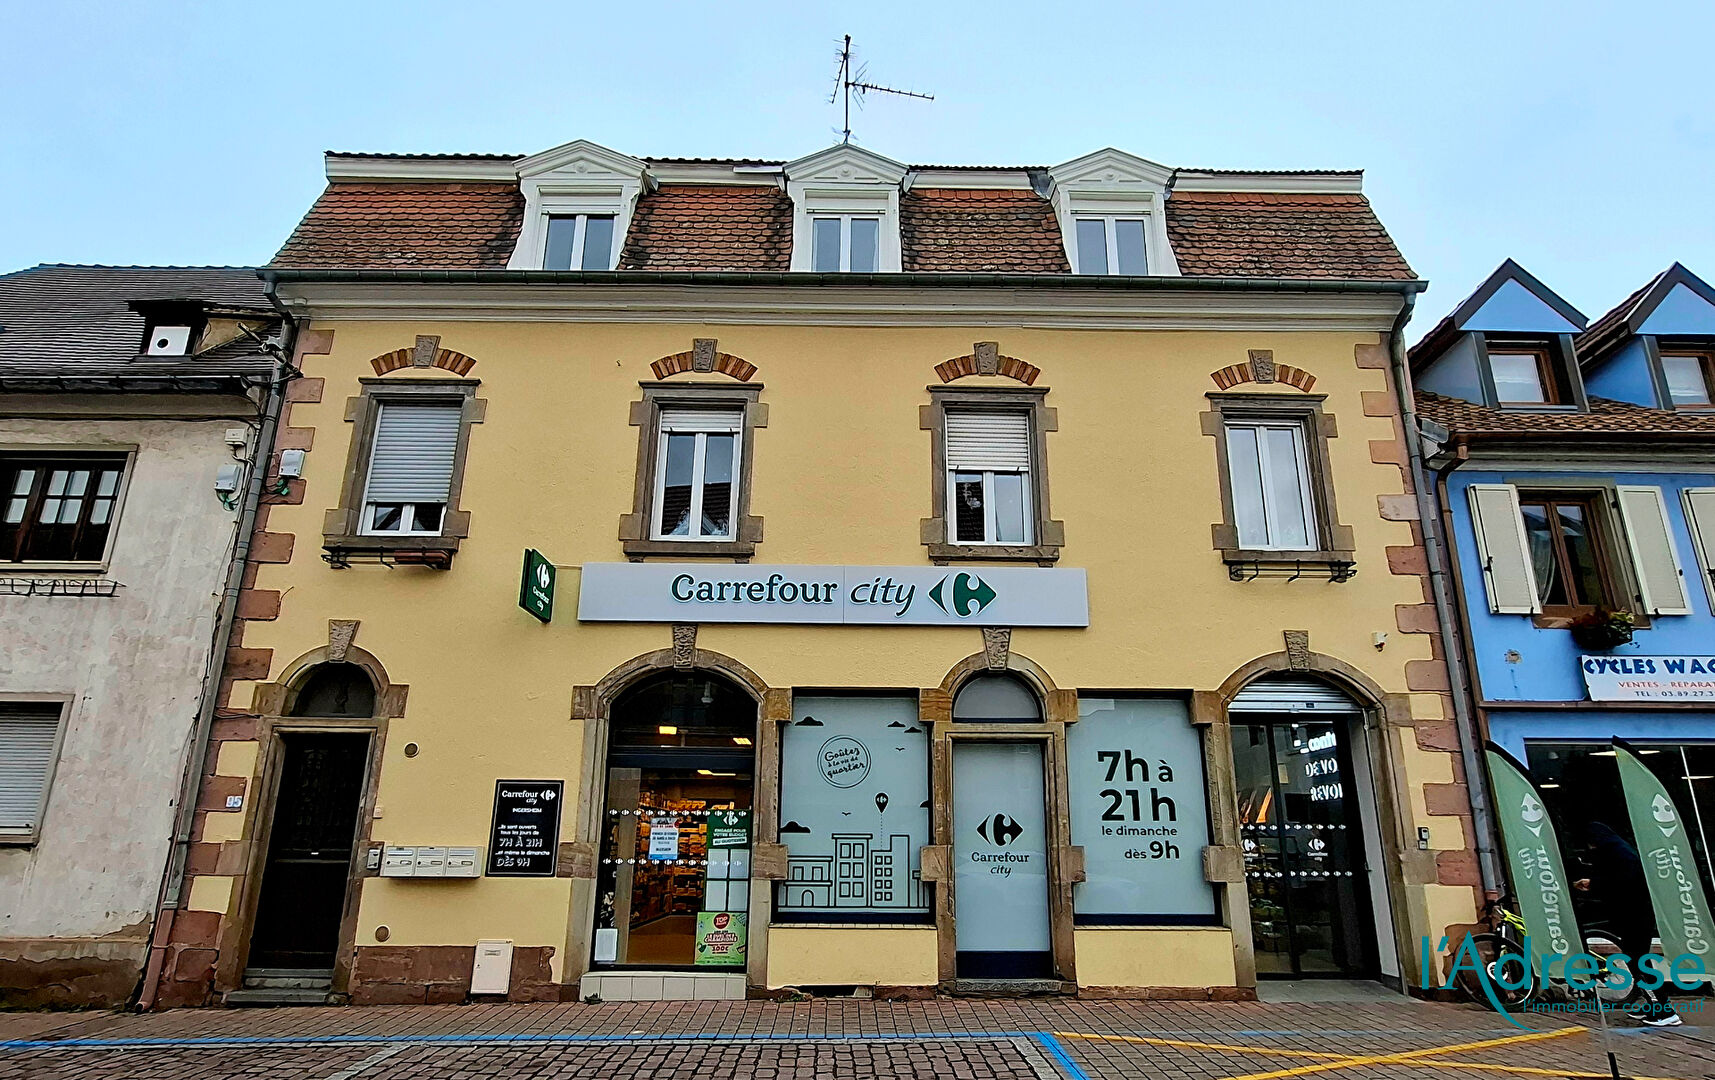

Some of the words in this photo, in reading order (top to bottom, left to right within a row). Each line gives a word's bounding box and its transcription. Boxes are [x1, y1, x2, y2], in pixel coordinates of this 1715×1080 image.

[532, 586, 550, 604] Carrefour
[672, 573, 838, 604] Carrefour
[850, 577, 916, 617] city
[1583, 658, 1657, 675] CYCLES
[825, 747, 860, 762] Goûtez
[827, 762, 866, 779] quartier
[1097, 749, 1150, 782] 7h
[1158, 759, 1174, 782] à
[501, 789, 539, 798] Carrefour
[1101, 825, 1113, 836] le
[1115, 825, 1178, 836] dimanche
[499, 837, 514, 848] 7H
[514, 835, 524, 848] À
[525, 838, 543, 848] 21H
[1124, 848, 1147, 859] dès
[1149, 840, 1180, 859] 9h
[496, 855, 515, 867] DÈS
[516, 857, 531, 867] 9H
[970, 852, 1030, 863] Carrefour
[990, 865, 1012, 879] city
